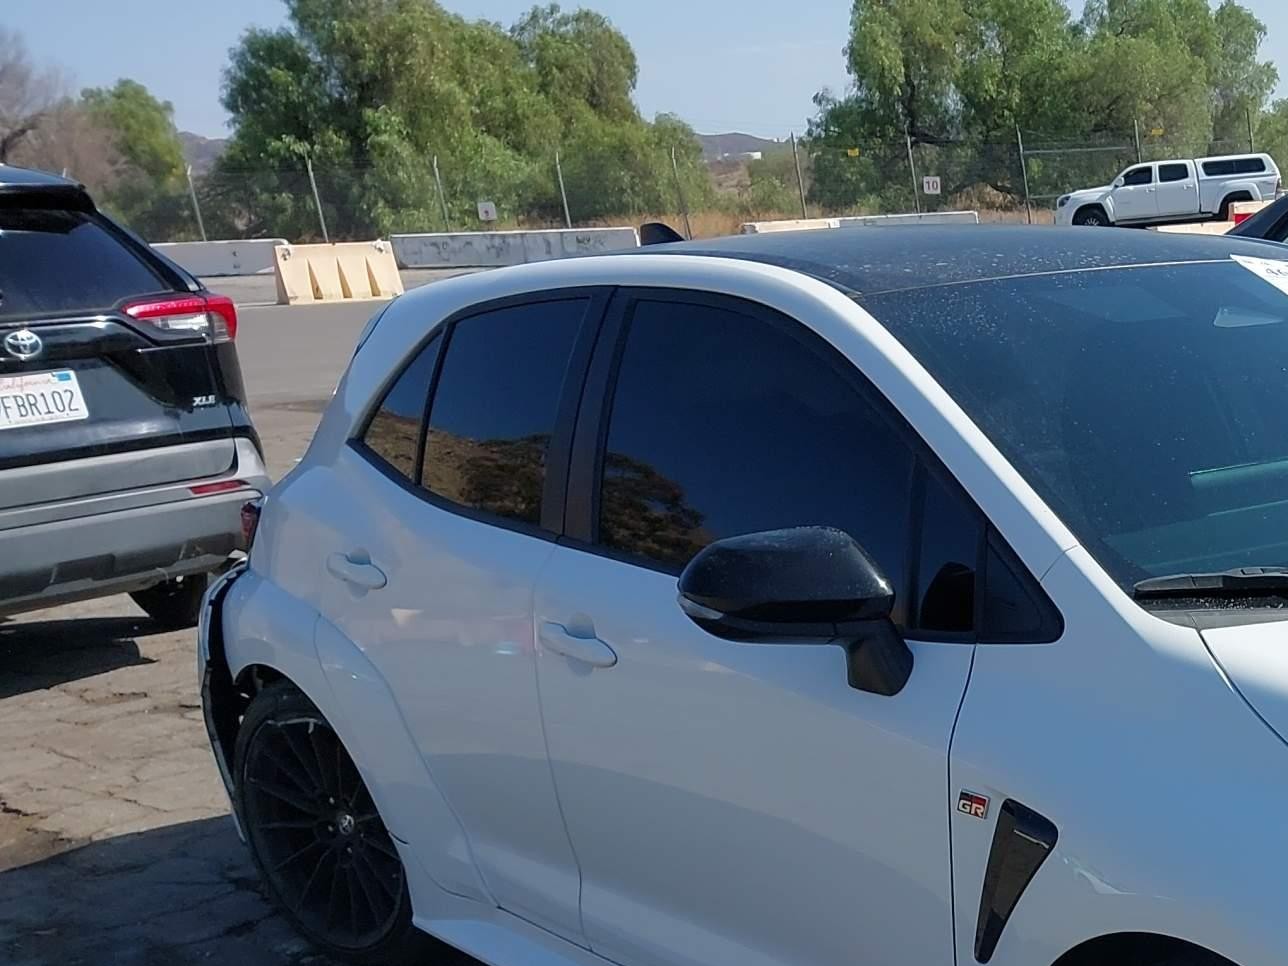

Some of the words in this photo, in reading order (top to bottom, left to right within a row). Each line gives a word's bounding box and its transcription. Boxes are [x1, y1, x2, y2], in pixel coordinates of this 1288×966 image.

[925, 180, 938, 191] 10
[0, 390, 79, 419] FBR102
[193, 395, 215, 406] XLE
[959, 800, 984, 817] GR
